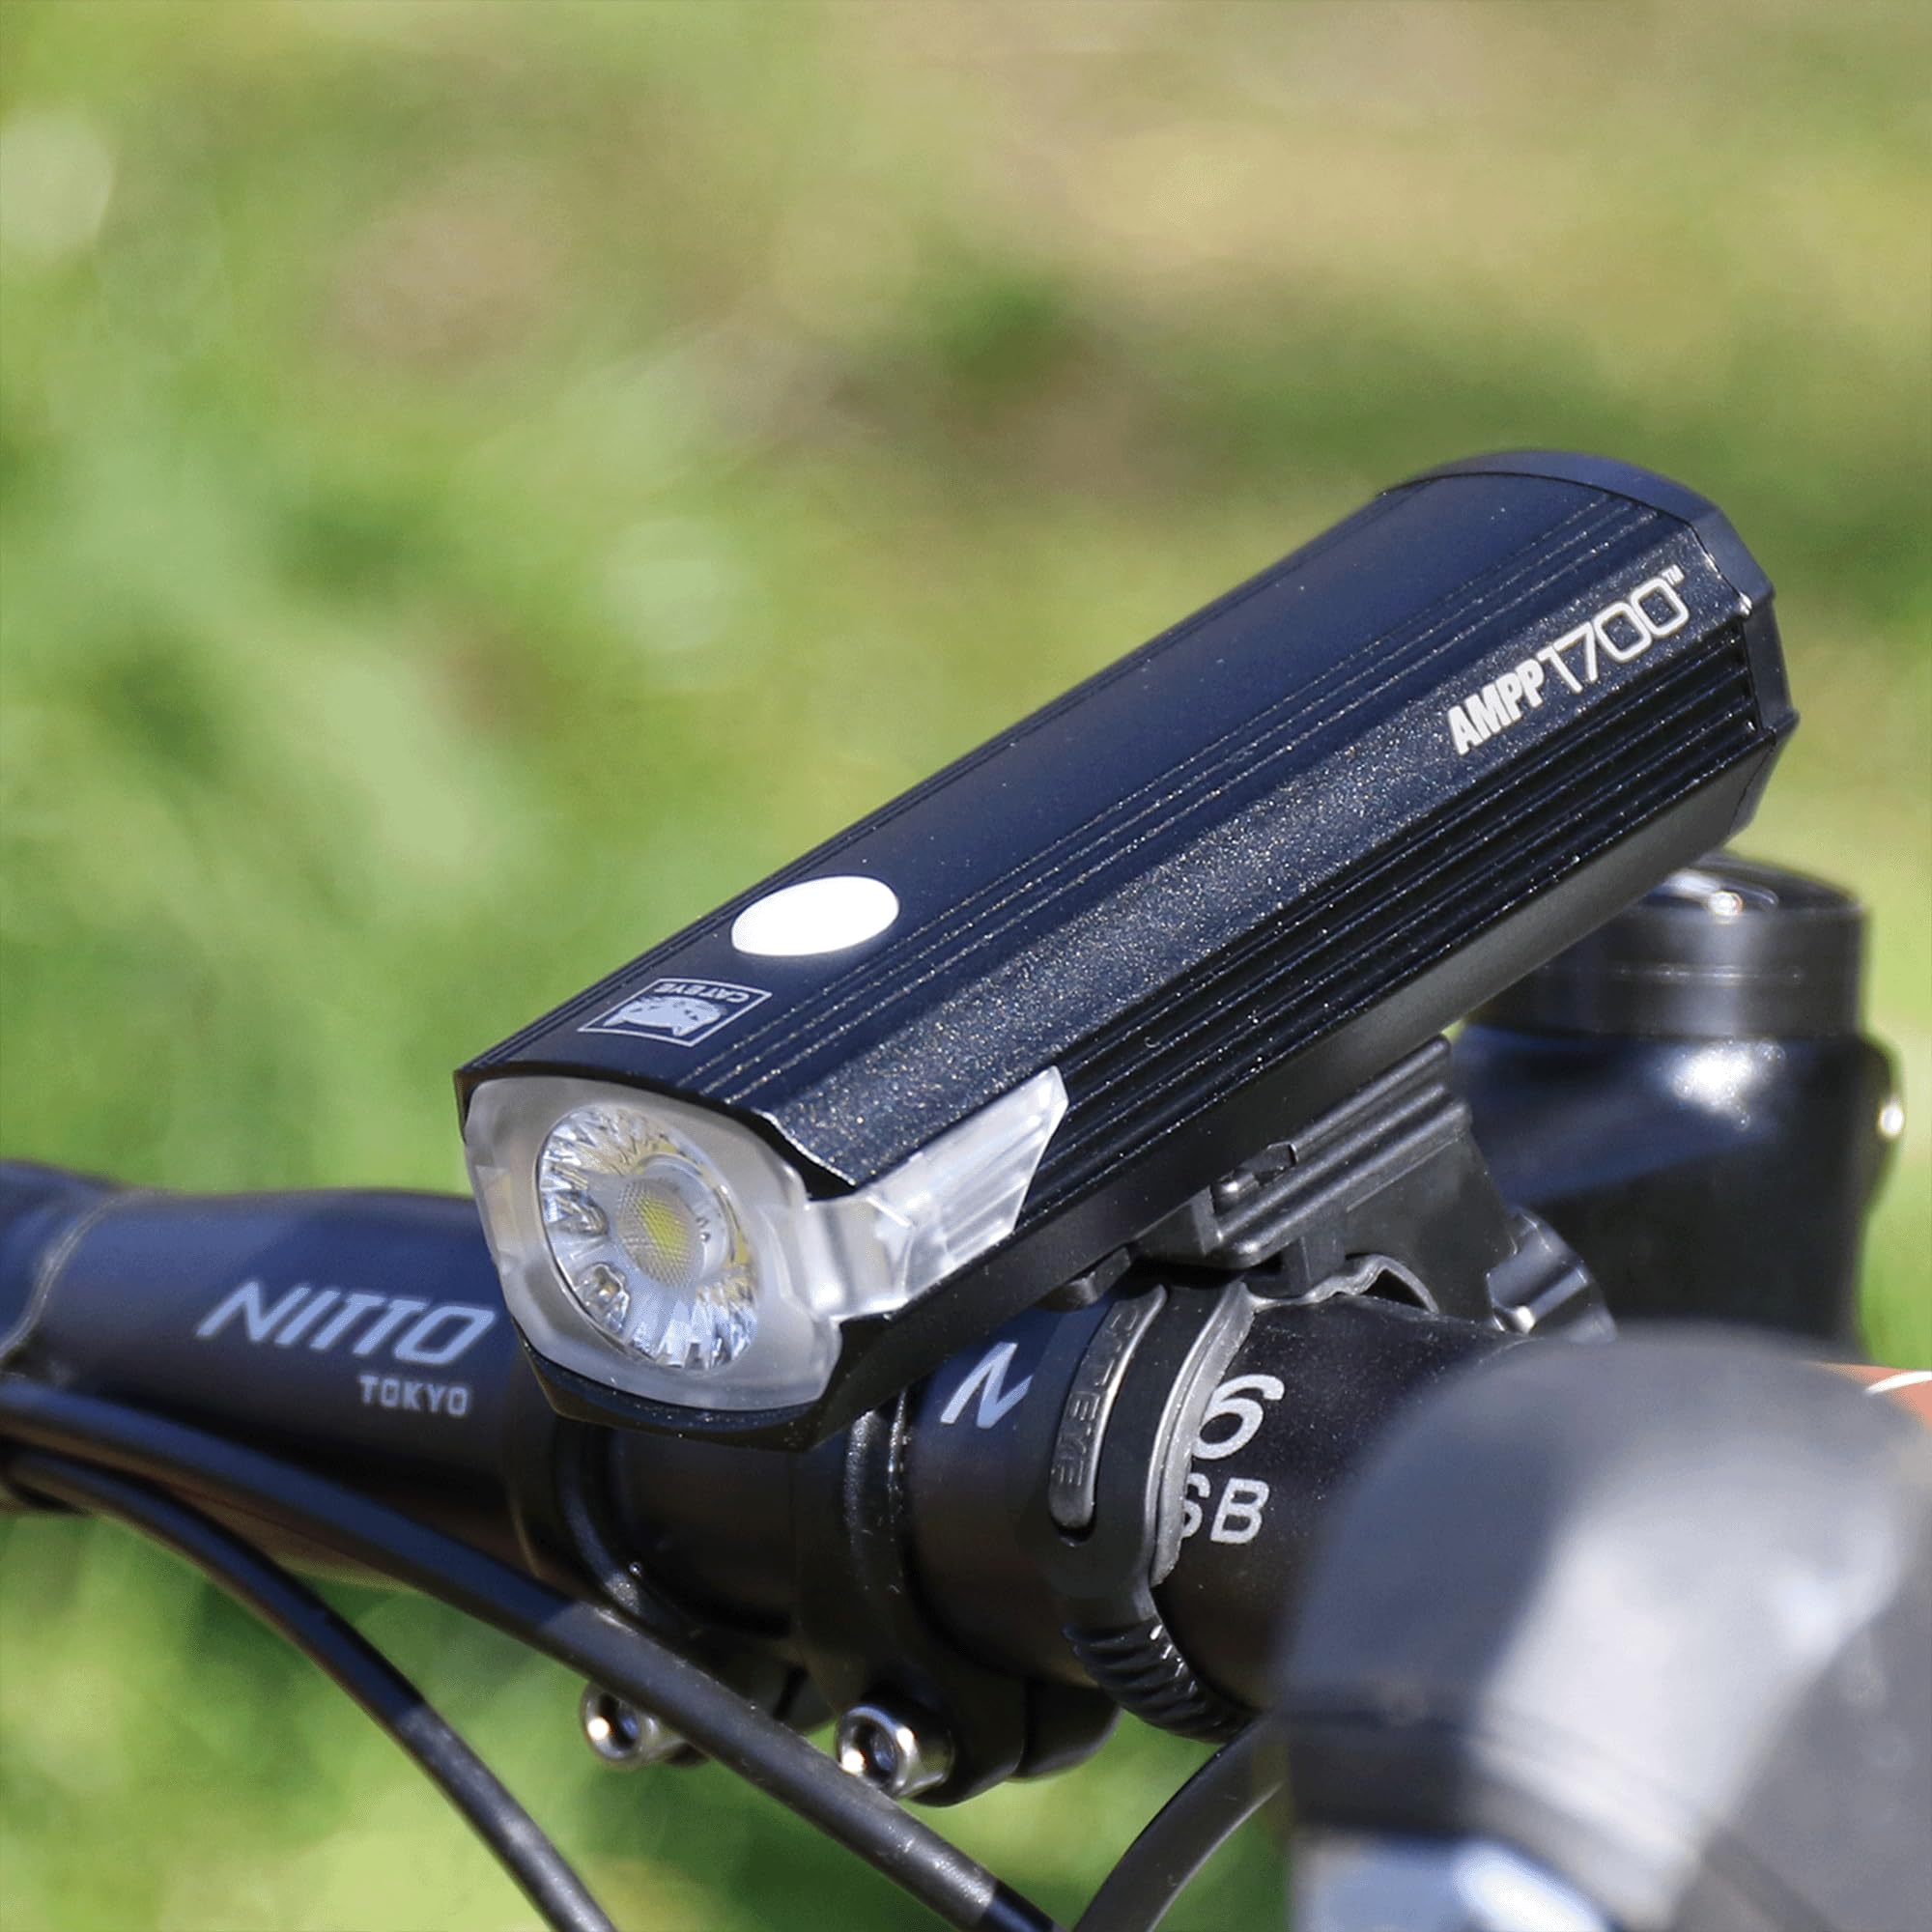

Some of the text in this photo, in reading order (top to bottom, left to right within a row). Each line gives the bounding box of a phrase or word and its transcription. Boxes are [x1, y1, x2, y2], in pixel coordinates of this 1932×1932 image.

[654, 982, 750, 1004] CATEYE
[195, 1281, 496, 1365] NITTO
[358, 1374, 469, 1417] TOKYO
